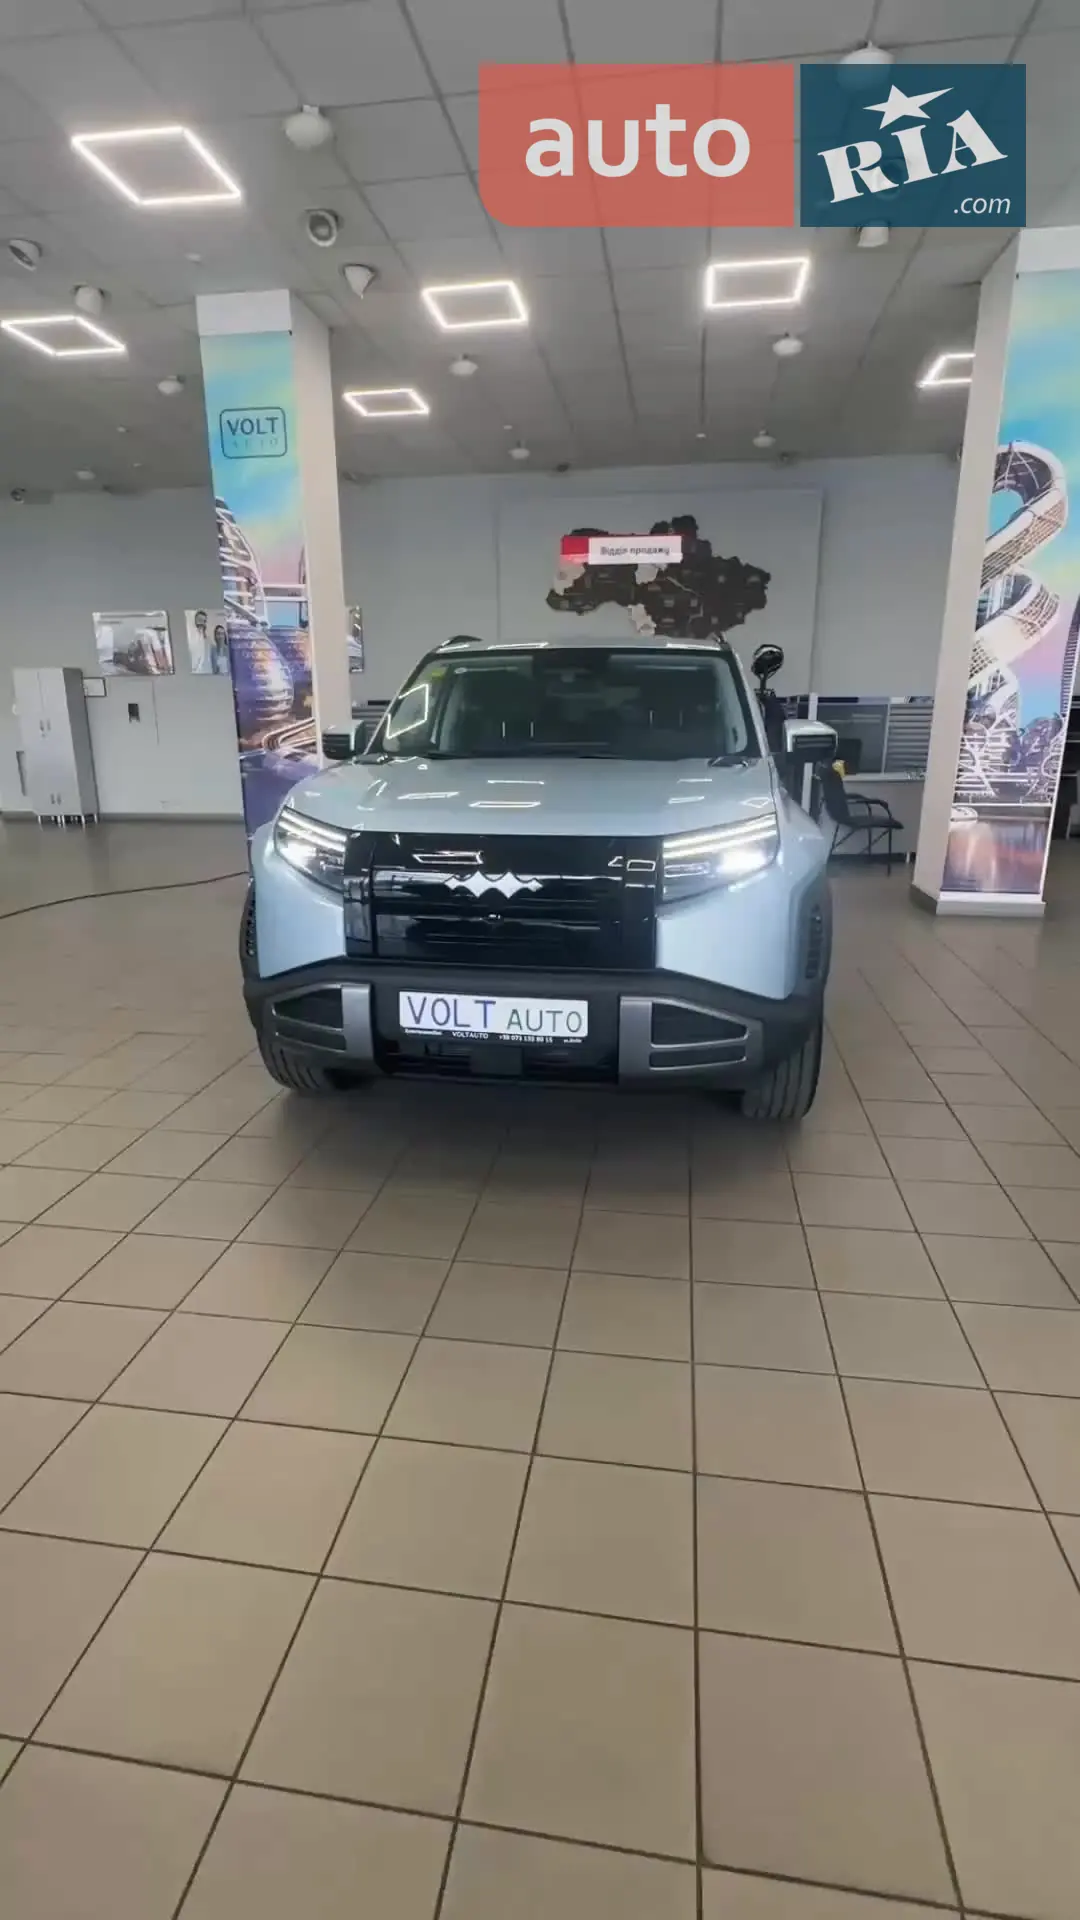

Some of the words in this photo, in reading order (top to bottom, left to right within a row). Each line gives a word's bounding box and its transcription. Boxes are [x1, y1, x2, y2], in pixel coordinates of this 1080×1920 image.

[226, 416, 279, 436] VOLT
[407, 996, 496, 1029] VOLT
[507, 1008, 582, 1033] AUTO
[452, 1031, 489, 1039] VOLTAUTO
